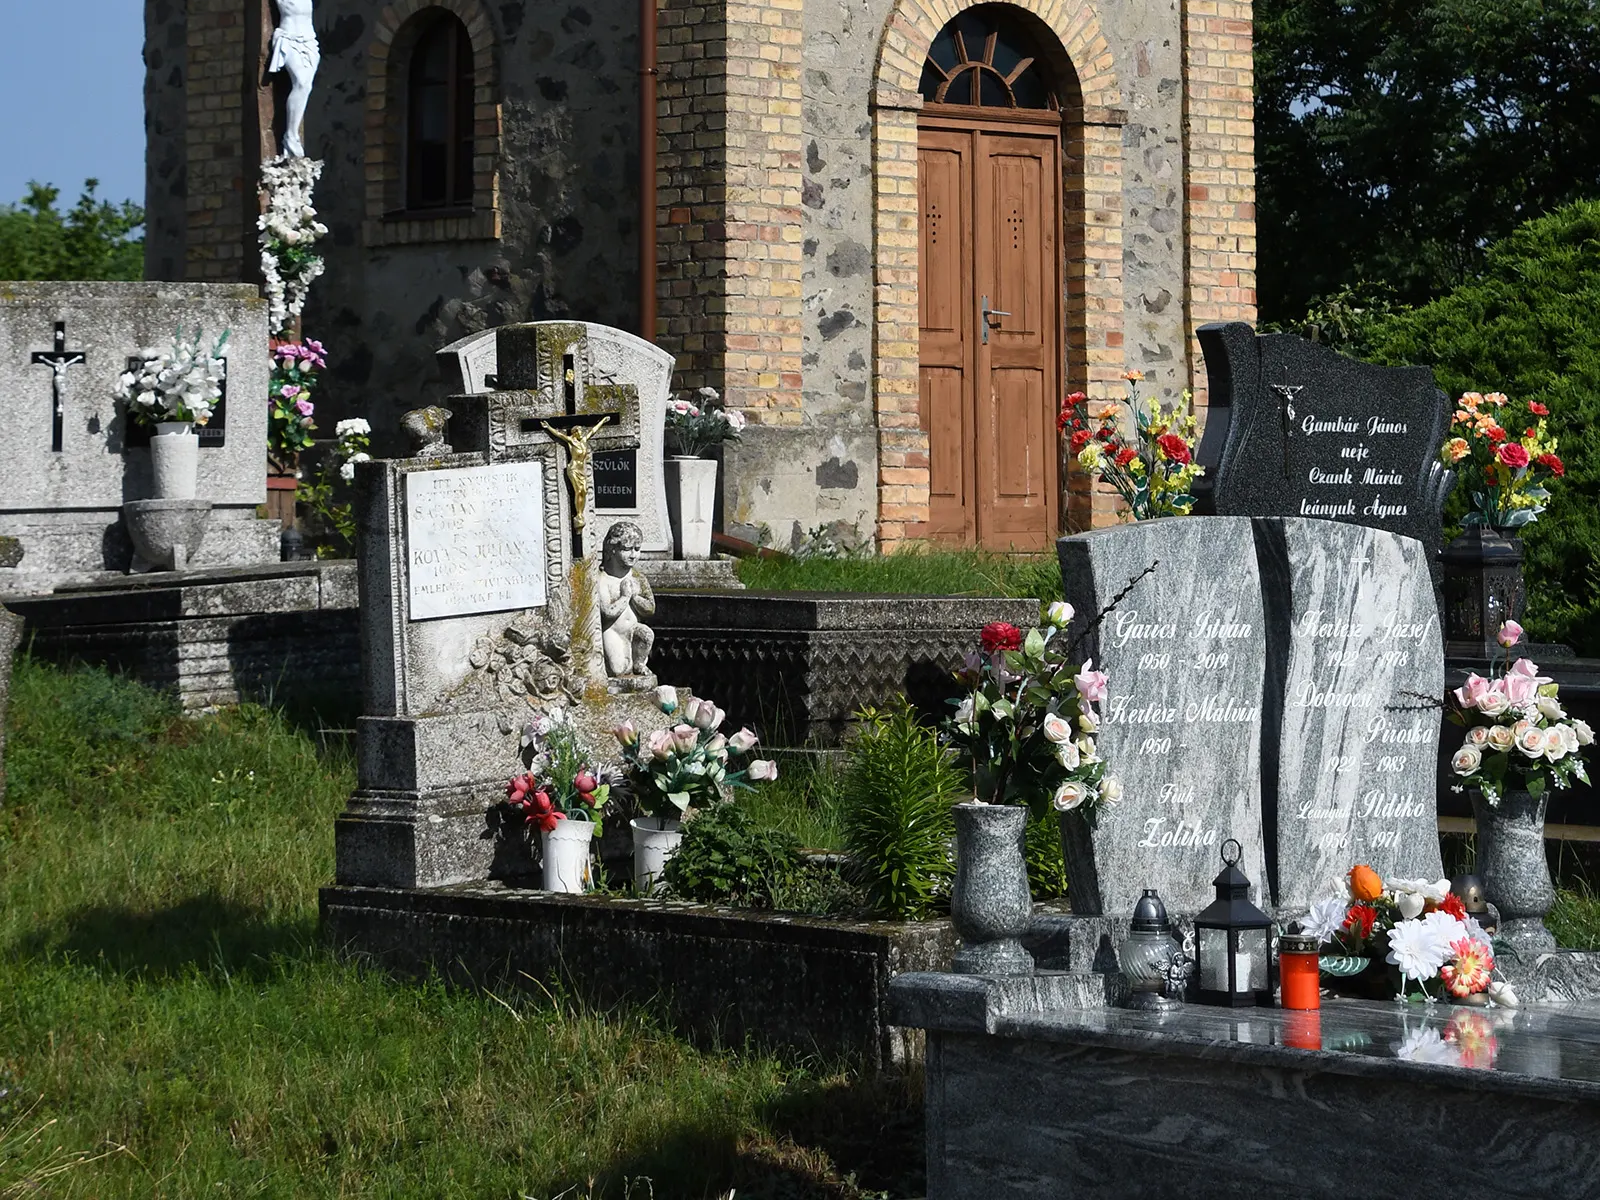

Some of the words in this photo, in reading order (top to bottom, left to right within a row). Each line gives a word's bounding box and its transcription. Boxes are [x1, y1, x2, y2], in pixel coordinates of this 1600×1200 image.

[1301, 415, 1360, 436] Gambár
[1366, 416, 1407, 436] János
[1341, 443, 1369, 462] neje
[1309, 466, 1353, 485] Czank
[1359, 467, 1403, 485] Mária
[1300, 498, 1356, 519] leányuk
[1364, 494, 1408, 519] Ágnes
[1113, 611, 1176, 648] Garics
[1189, 610, 1252, 639] István
[1376, 611, 1437, 647] József
[1138, 653, 1170, 670] 1950
[1194, 652, 1229, 670] 2019
[1328, 650, 1359, 667] 1922
[1379, 650, 1409, 667] 1978
[1293, 679, 1374, 708] Dobrocsi
[1105, 695, 1177, 725] Kertész
[1186, 694, 1259, 723] Malvin
[1362, 715, 1435, 744] Piroska
[1138, 737, 1171, 755] 1950
[1325, 755, 1357, 772] 1922
[1376, 755, 1407, 772] 1983
[1358, 789, 1425, 818] Ildikó
[1138, 817, 1217, 848] Zolika
[1319, 832, 1349, 849] 1956
[1371, 831, 1402, 848] 1971
